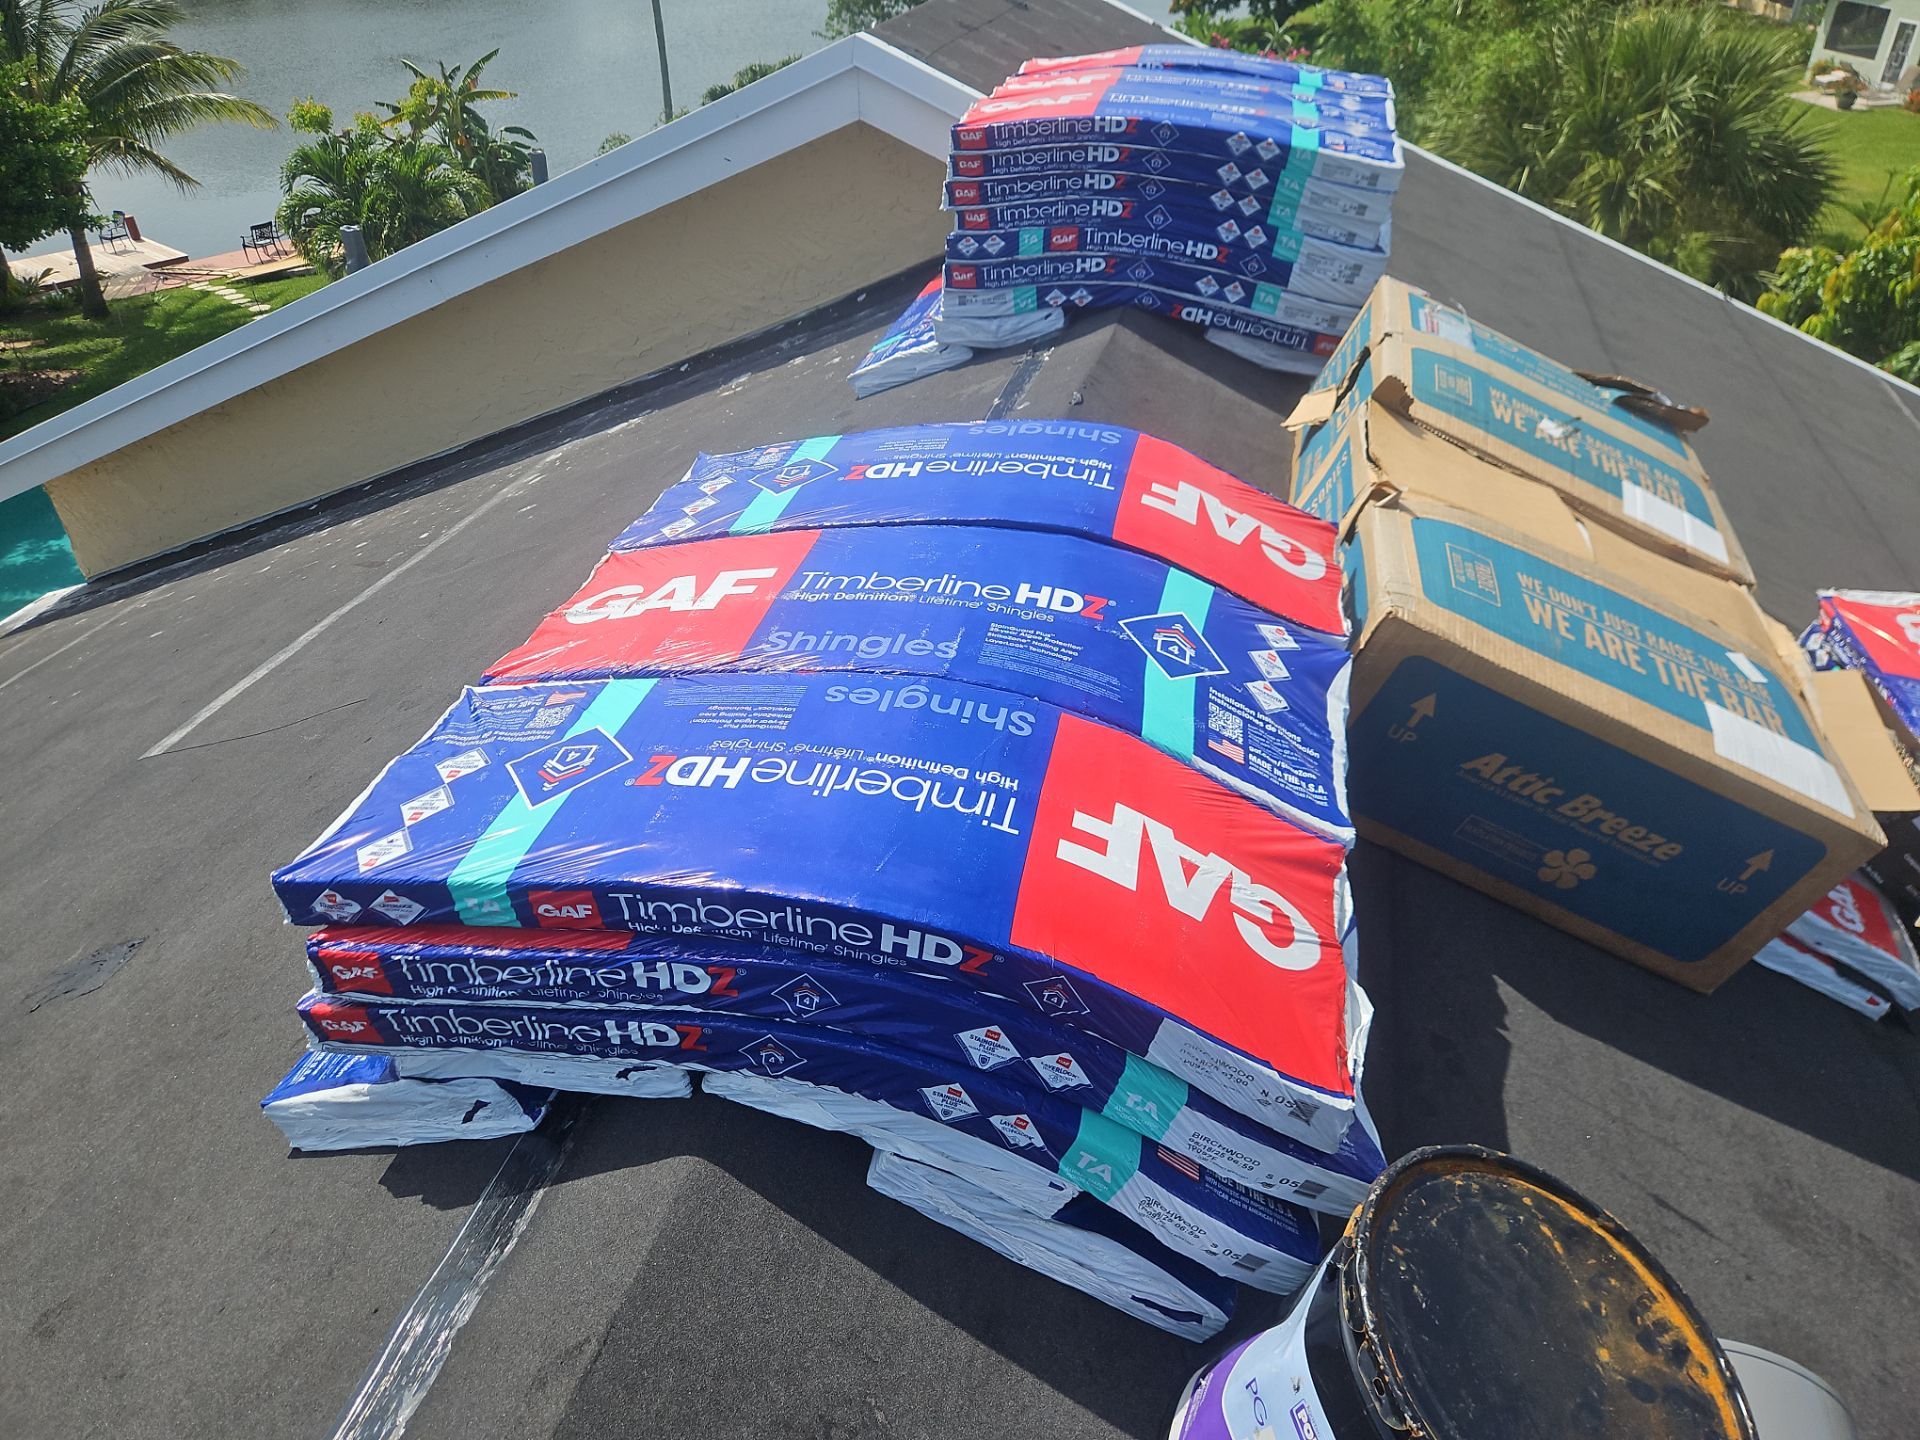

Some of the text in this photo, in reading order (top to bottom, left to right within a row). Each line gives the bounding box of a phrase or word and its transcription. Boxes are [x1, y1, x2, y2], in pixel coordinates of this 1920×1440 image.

[980, 92, 1094, 113] GAF
[960, 131, 983, 141] GAF
[991, 118, 1093, 140] Timberline
[959, 160, 982, 169] GAF
[991, 147, 1085, 170] Timberline
[955, 189, 977, 198] GAF
[984, 174, 1127, 197] Timberline HDZ
[1281, 178, 1300, 191] TA
[997, 200, 1134, 221] Timberline HDZ
[1275, 205, 1291, 217] TA
[1052, 233, 1076, 244] GAF
[1084, 228, 1229, 264] Timberline HDZ
[1281, 236, 1297, 249] TA
[953, 272, 974, 282] GAF
[982, 258, 1117, 281] Timberline HDZ
[1258, 293, 1275, 304] TA
[1169, 303, 1214, 326] HDZ
[1213, 312, 1308, 350] Timberline
[968, 424, 1122, 445] Shingles
[1490, 399, 1528, 433] WE
[1586, 441, 1632, 482] THE
[1010, 454, 1080, 465] Definition
[1080, 458, 1112, 471] High
[844, 459, 1116, 491] Timberline HDZ
[1140, 480, 1328, 582] GAF
[565, 567, 779, 626] GAF
[796, 591, 1056, 623] High Definition Lifetime Shingles
[800, 571, 1109, 622] Timberline HDZ
[1019, 632, 1043, 641] Algae
[1516, 571, 1546, 597] WE
[1548, 585, 1598, 621] DON'T
[1603, 610, 1642, 641] JUST
[1645, 629, 1699, 667] RAISE
[1701, 655, 1732, 684] THE
[768, 630, 958, 660] Shingles
[1028, 645, 1073, 662] Technology
[1059, 647, 1079, 657] Area
[1168, 643, 1181, 657] 4
[1523, 593, 1788, 738] WE ARE THE BAR
[825, 685, 1037, 737] Shingles
[1208, 692, 1277, 733] Instrucciones de
[1209, 686, 1256, 719] Installation
[1386, 722, 1418, 743] UP
[712, 739, 1020, 792] High Definition Lifetime Shingles
[1248, 753, 1273, 773] MADE
[636, 754, 1020, 836] Timberline HDZ
[1460, 752, 1565, 804] Attic
[1556, 793, 1684, 861] Breeze
[1055, 801, 1322, 971] GAF
[1716, 877, 1749, 895] UP
[538, 904, 593, 919] GAF
[608, 892, 995, 977] Timberline HDZ
[763, 931, 908, 967] Lifetime Shingles
[332, 964, 378, 980] GAF
[391, 955, 739, 998] Timberline HDZ
[410, 984, 444, 998] High
[321, 1018, 368, 1034] GAF
[378, 1008, 708, 1052] Timberline HDZ
[400, 1033, 434, 1046] High
[969, 1034, 1011, 1052] STAINGUARD
[978, 1042, 997, 1053] PLUS
[941, 1099, 961, 1108] PLUS
[1260, 1088, 1270, 1098] N
[1191, 1131, 1261, 1168] BIRCHWOOD
[1077, 1151, 1112, 1184] TA
[1226, 1156, 1255, 1172] 06:59
[1278, 1177, 1300, 1188] 05
[1247, 1187, 1267, 1205] THE
[1248, 1206, 1273, 1223] AMERICAN
[1221, 1248, 1242, 1261] 05
[1245, 1377, 1268, 1427] PG
[1296, 1406, 1318, 1440] PO
